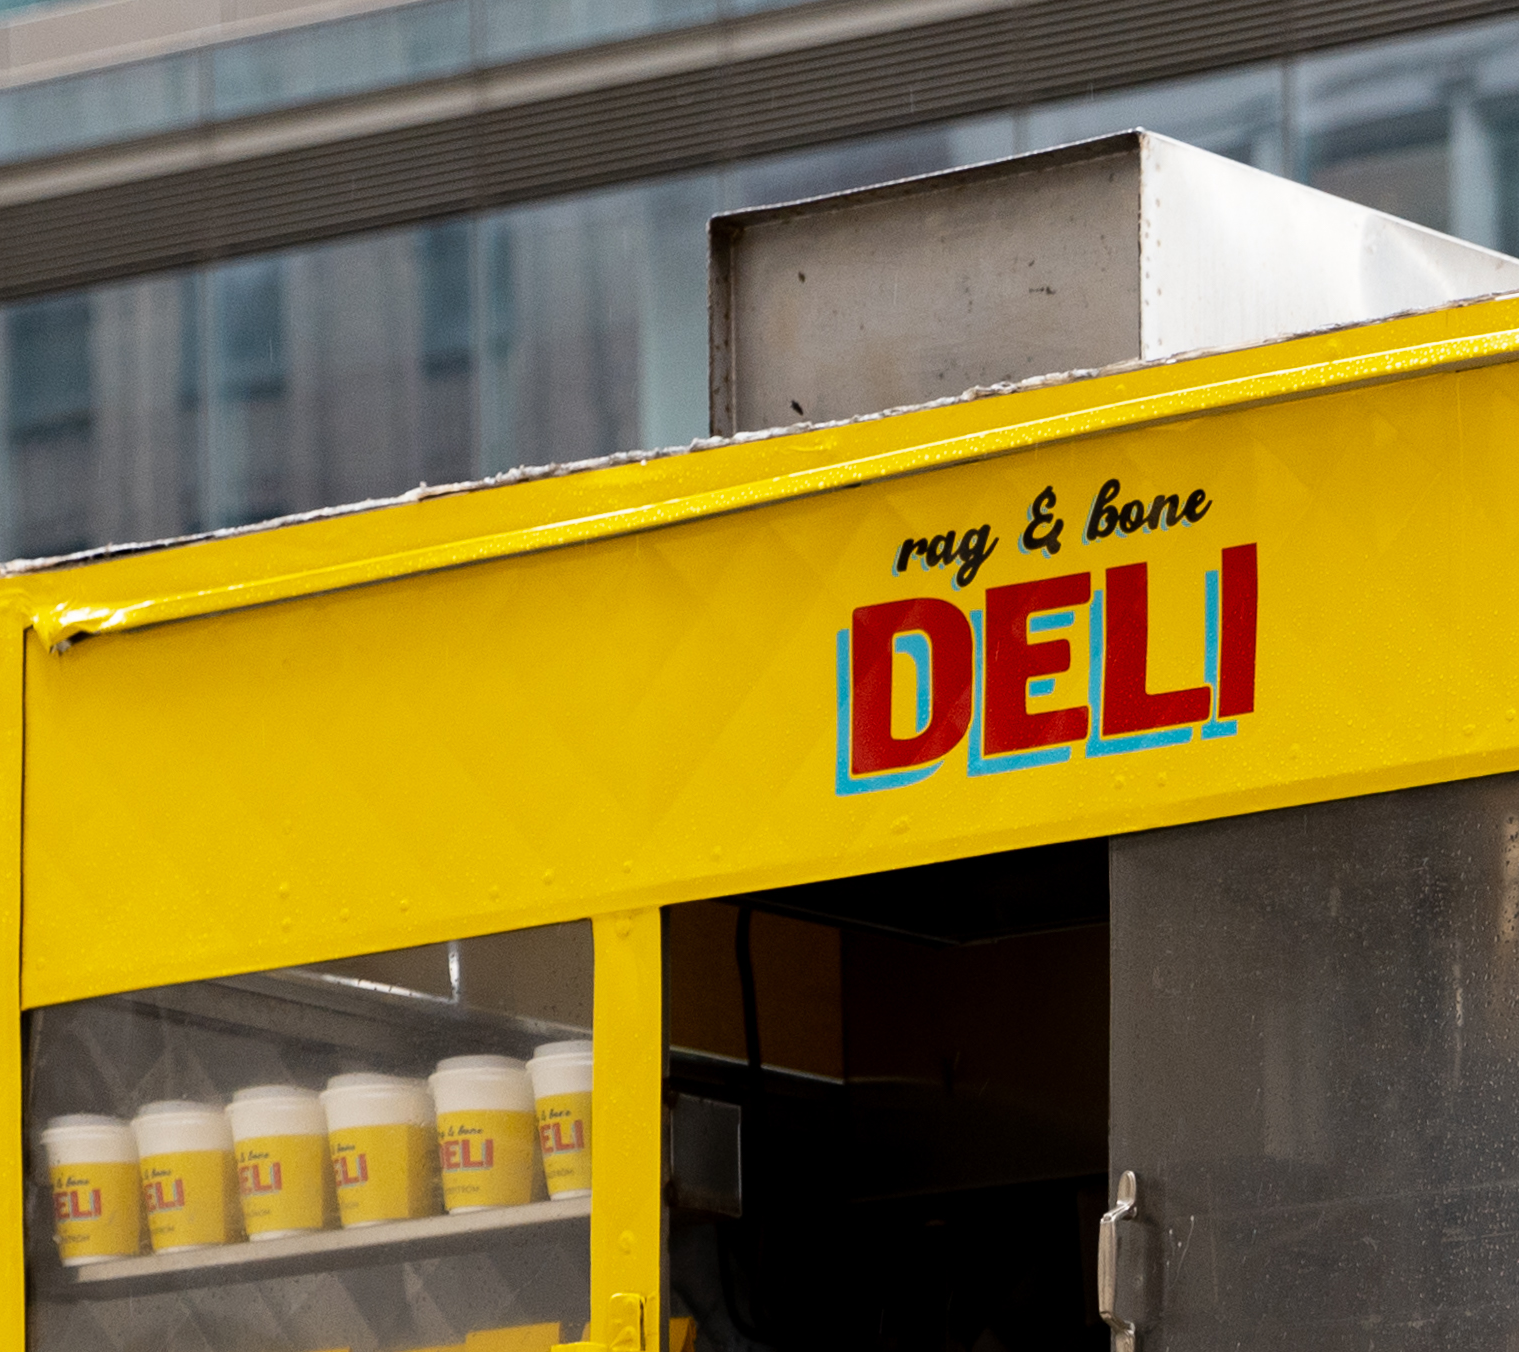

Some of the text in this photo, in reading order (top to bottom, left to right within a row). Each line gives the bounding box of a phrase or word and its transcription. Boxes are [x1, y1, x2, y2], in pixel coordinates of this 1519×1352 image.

[890, 479, 1213, 589] rag & bone
[836, 542, 1258, 797] DELI
[540, 1119, 585, 1156] ELI
